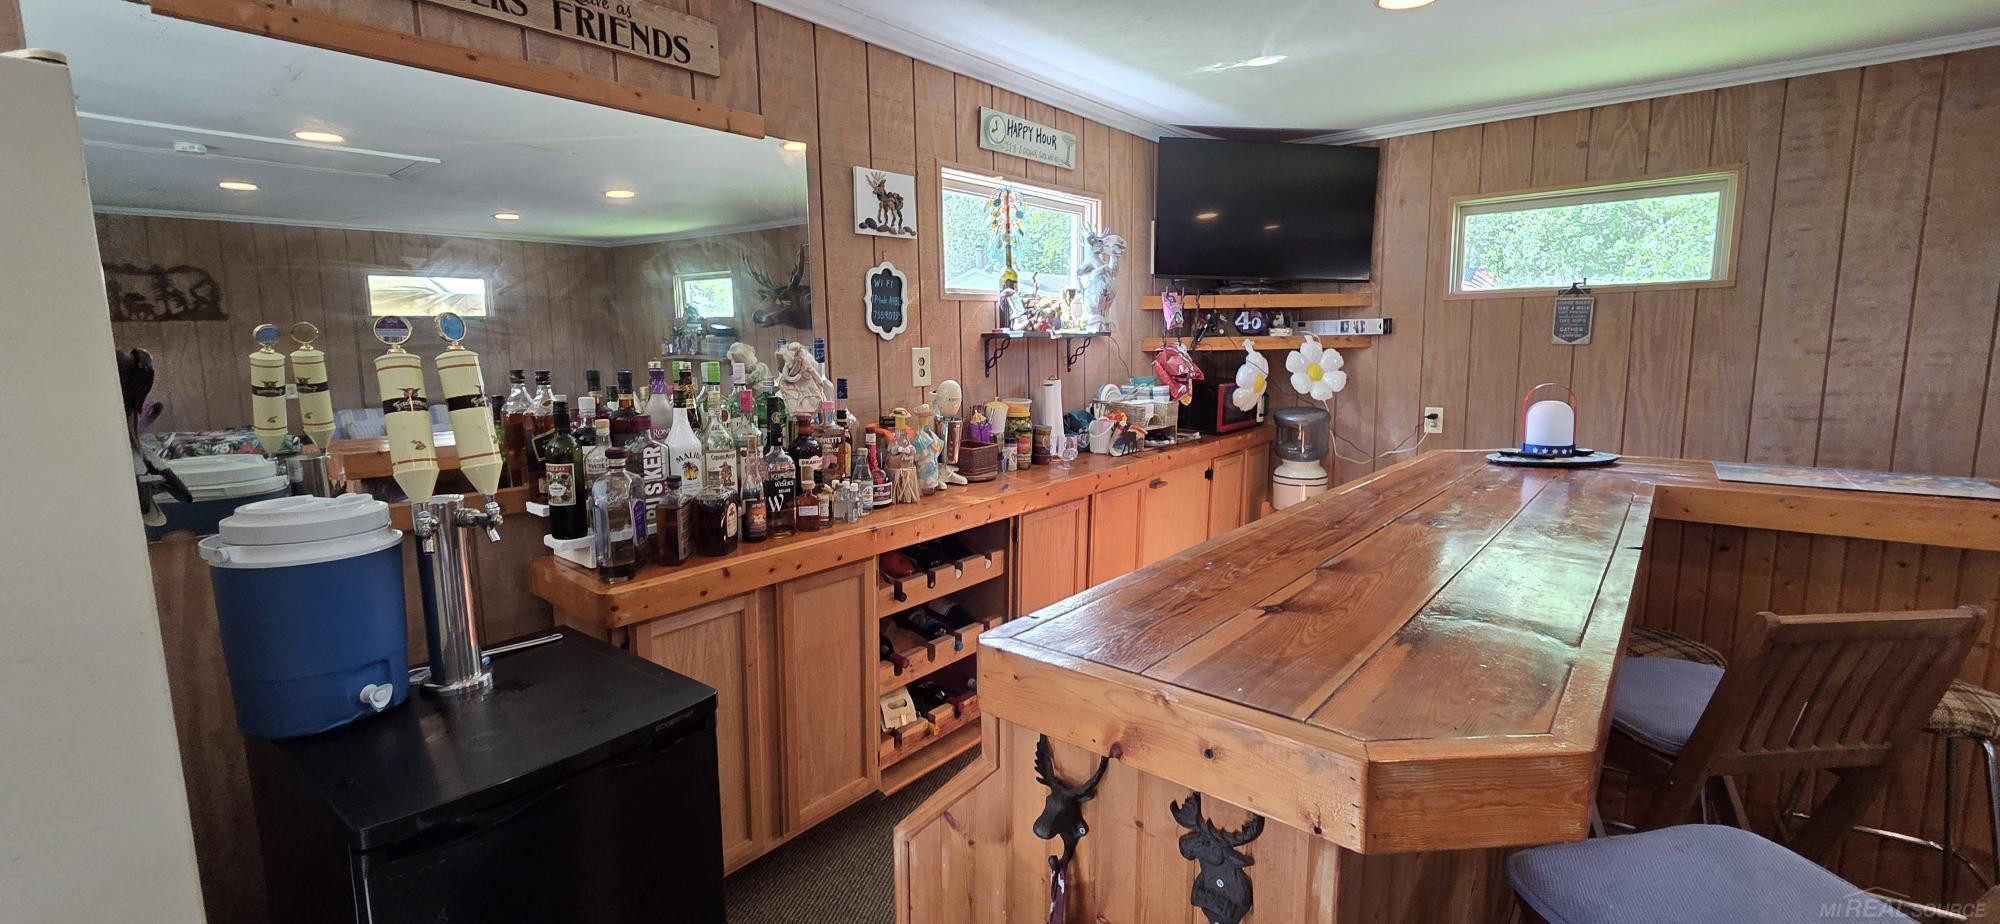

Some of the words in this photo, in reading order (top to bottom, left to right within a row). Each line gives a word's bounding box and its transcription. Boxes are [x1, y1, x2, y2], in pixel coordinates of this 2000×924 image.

[616, 4, 632, 18] as
[553, 0, 691, 64] FRIENDS
[1006, 118, 1034, 142] HAPPY
[1035, 128, 1057, 150] HOUR
[1235, 311, 1261, 330] 40
[768, 494, 784, 512] W
